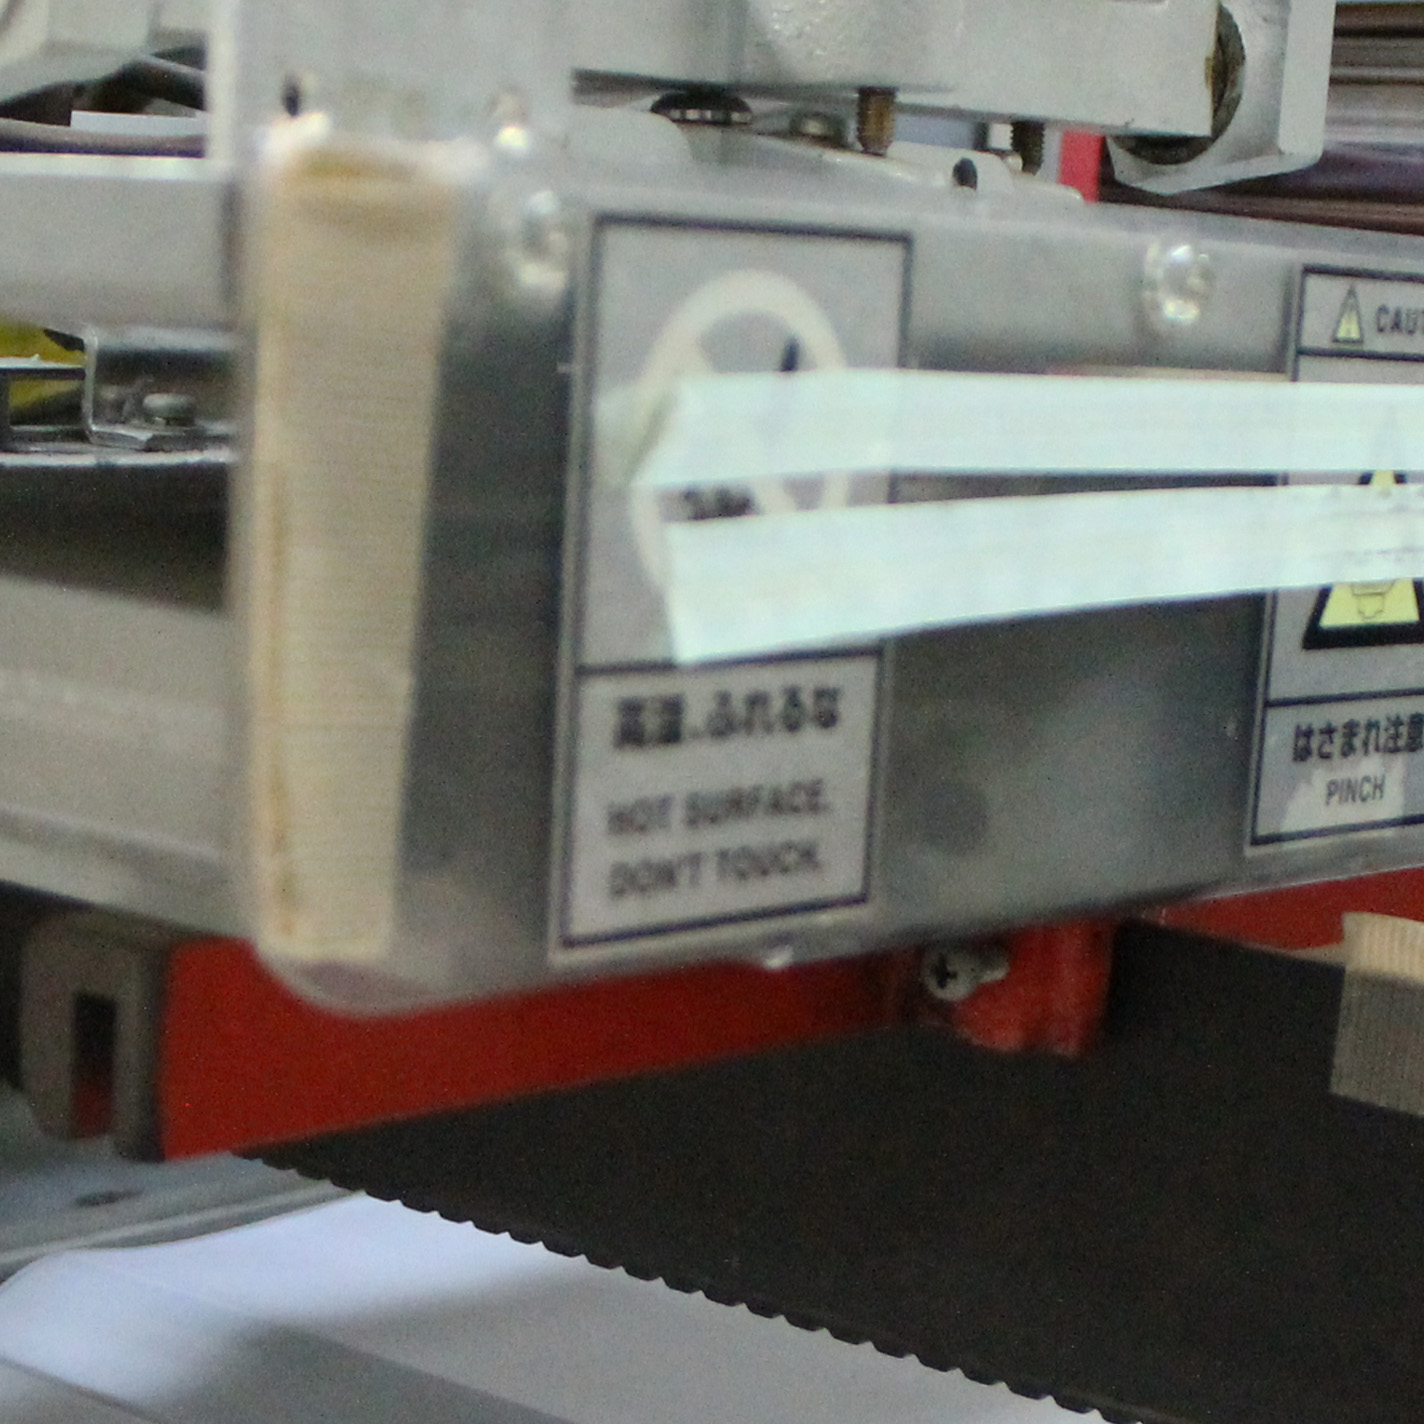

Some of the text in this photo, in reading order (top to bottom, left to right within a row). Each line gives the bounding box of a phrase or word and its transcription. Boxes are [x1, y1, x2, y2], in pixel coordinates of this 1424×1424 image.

[1325, 774, 1386, 806] PINCH
[607, 795, 673, 836] HOT
[610, 850, 703, 898] DON'T
